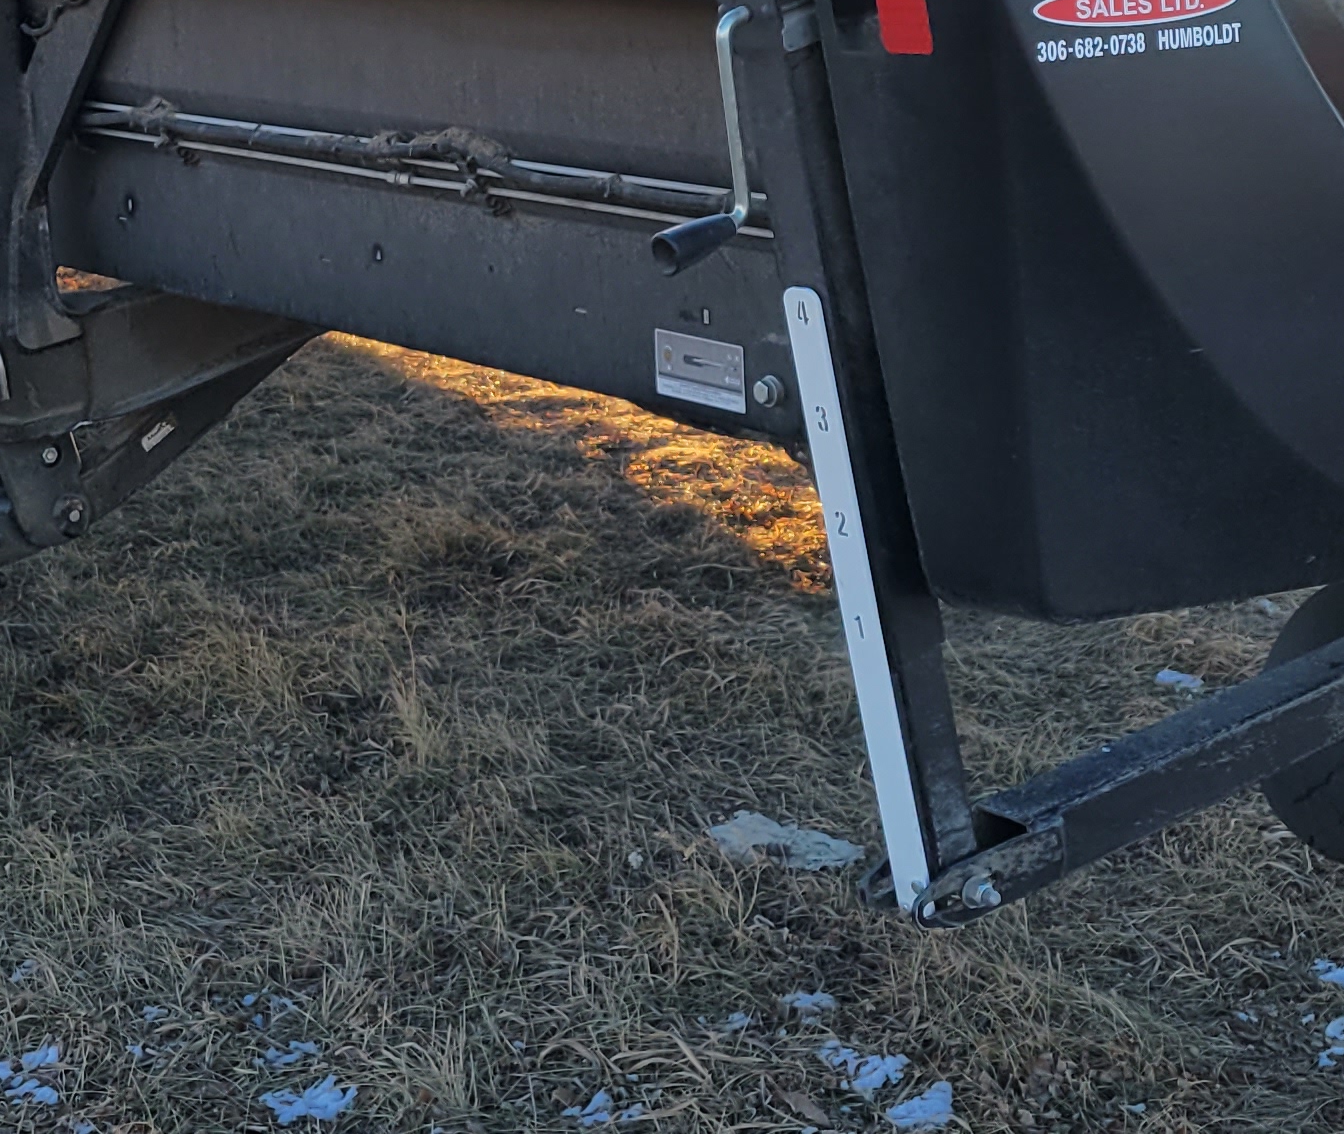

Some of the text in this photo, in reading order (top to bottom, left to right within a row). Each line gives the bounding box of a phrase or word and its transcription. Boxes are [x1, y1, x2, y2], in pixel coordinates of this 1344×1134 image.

[1036, 22, 1243, 63] 306-682-0738 HUMBOLDT
[796, 300, 810, 325] 4
[815, 405, 829, 432] 3
[834, 511, 849, 537] 2
[853, 615, 865, 640] 1
